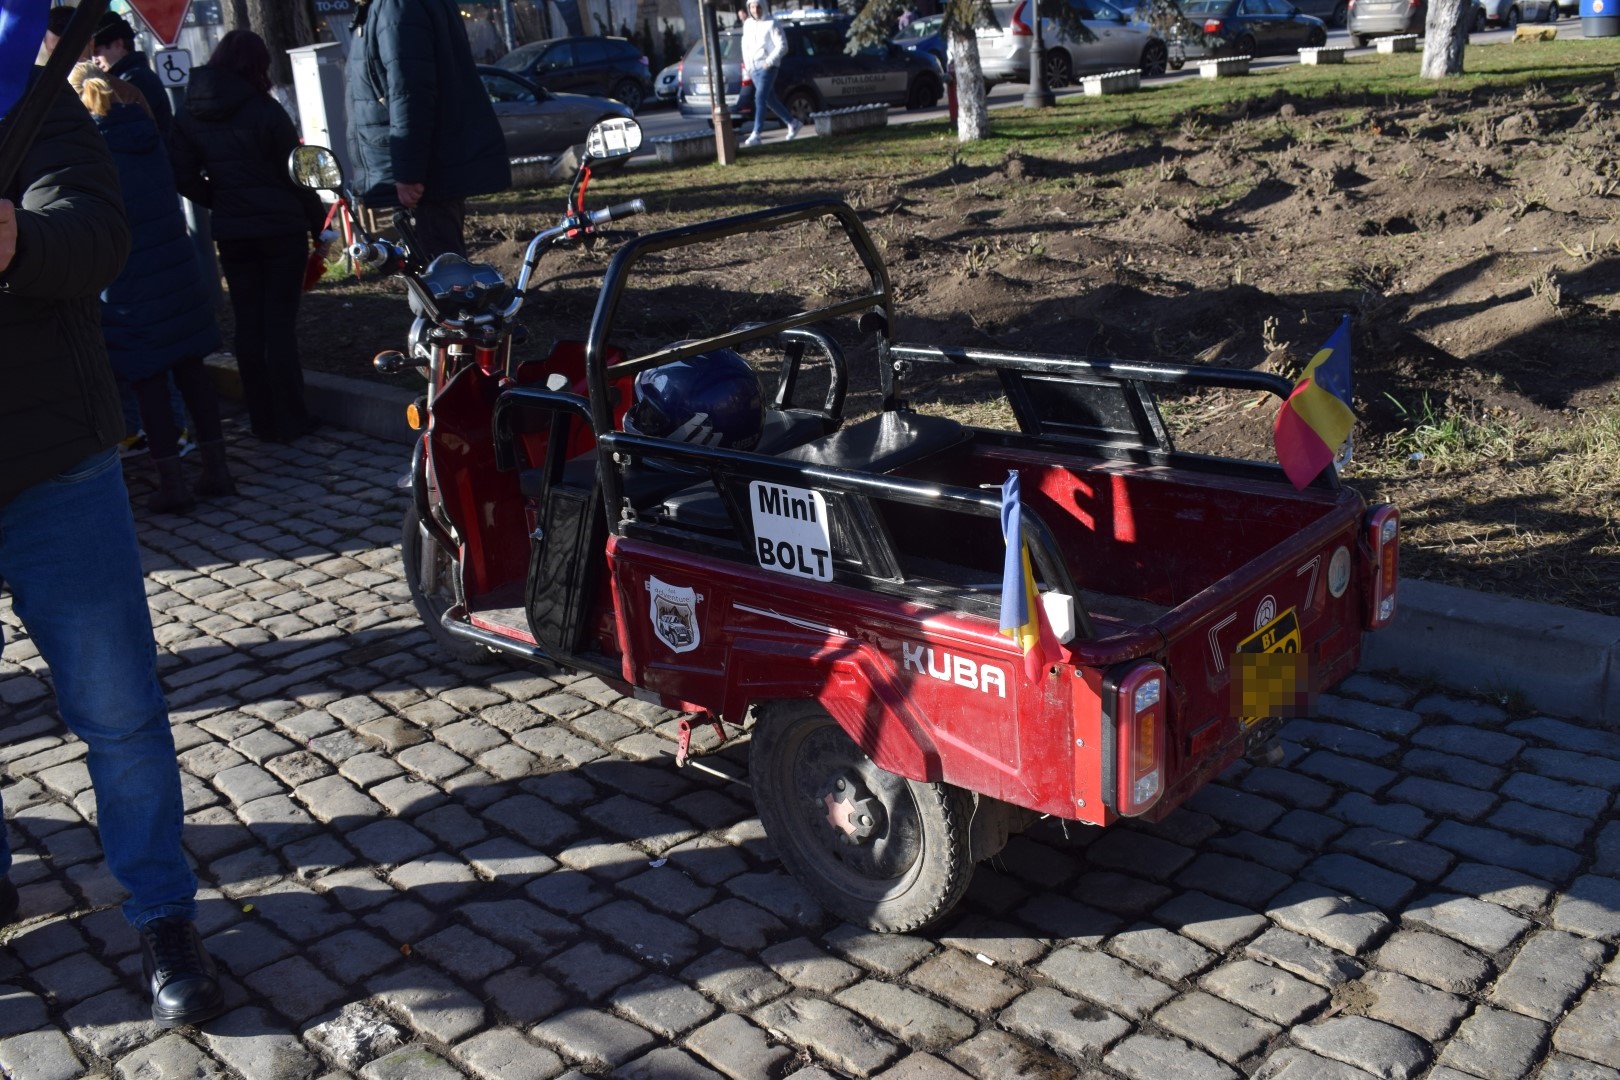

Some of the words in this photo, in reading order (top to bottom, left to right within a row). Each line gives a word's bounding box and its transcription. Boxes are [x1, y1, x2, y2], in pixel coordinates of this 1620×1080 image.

[316, 1, 350, 11] TO-GO
[757, 485, 816, 522] Mini
[757, 536, 829, 578] BOLT
[1261, 628, 1276, 650] BT
[902, 640, 1007, 699] KUBA
